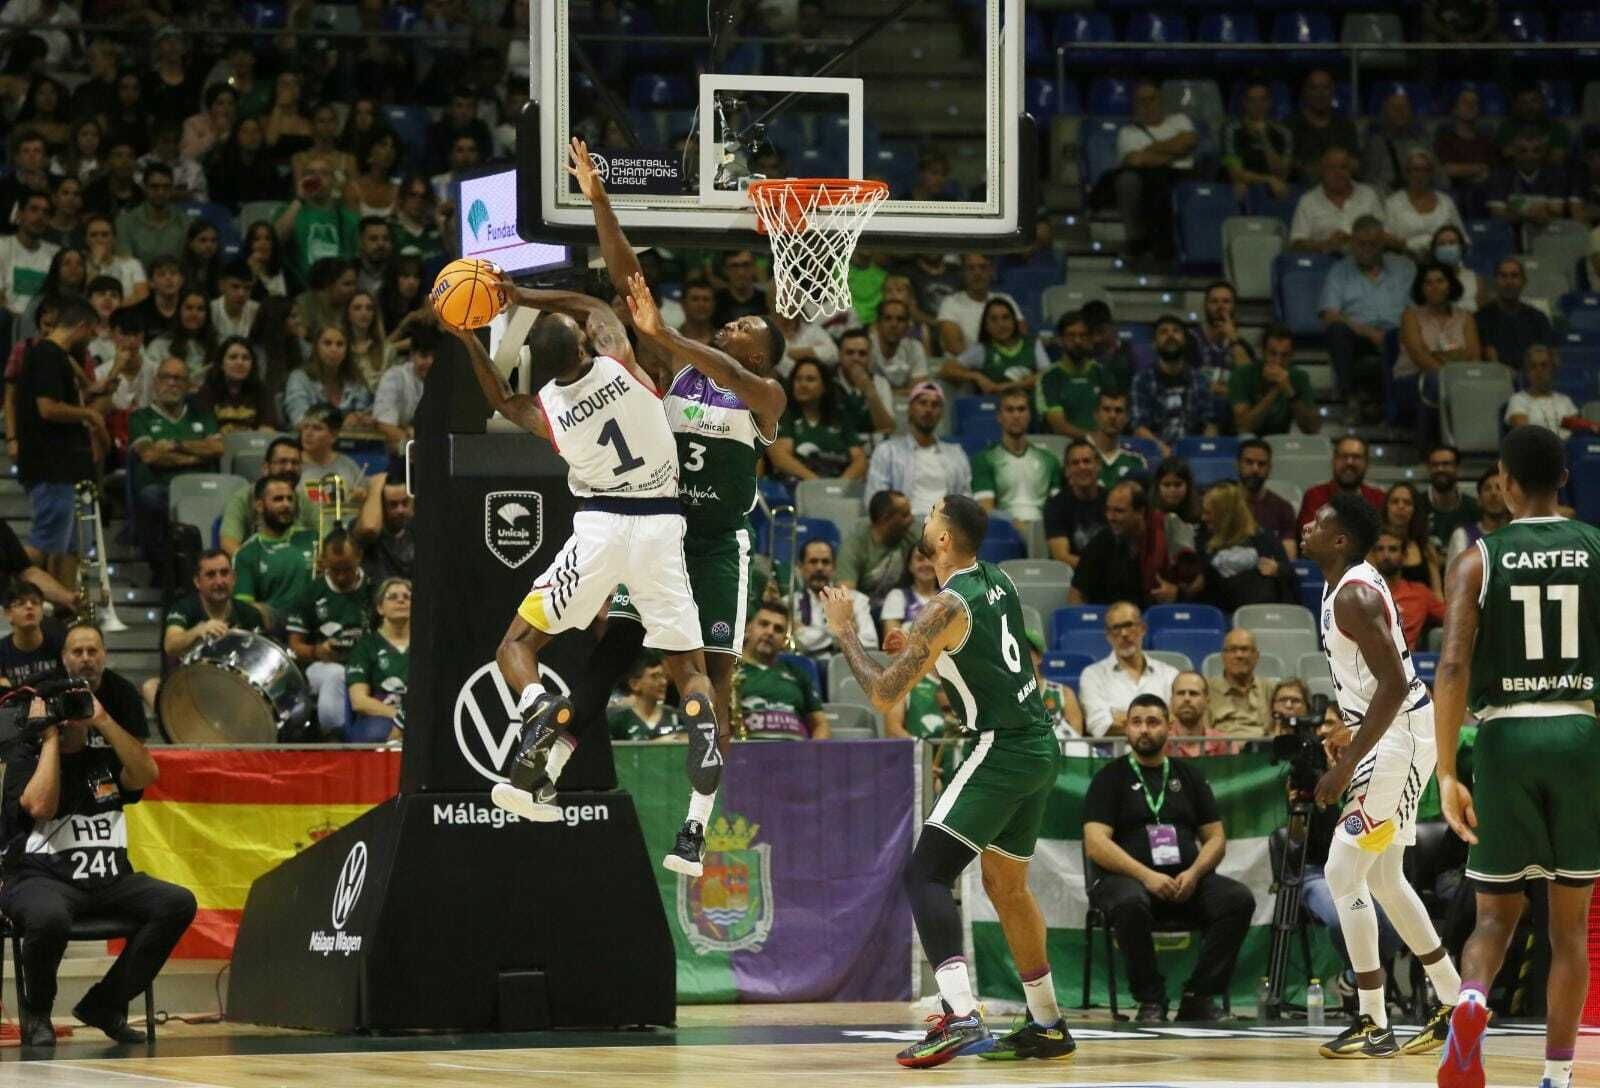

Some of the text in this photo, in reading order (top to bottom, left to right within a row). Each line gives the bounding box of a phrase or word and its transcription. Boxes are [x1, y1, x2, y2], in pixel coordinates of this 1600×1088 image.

[611, 158, 671, 168] BASKETBALL
[611, 167, 678, 178] CHAMPIONS
[611, 177, 648, 186] LEAGUE
[558, 375, 631, 432] MCDUFFIE
[597, 417, 645, 476] 1
[683, 441, 707, 472] 3
[497, 527, 530, 539] Unicaja
[1501, 550, 1590, 569] CARTER
[1510, 584, 1579, 660] 11
[1001, 613, 1021, 673] 6
[1502, 673, 1594, 692] BENAHAVÍS
[72, 818, 111, 842] HB
[71, 850, 119, 880] 241
[309, 930, 362, 957] Málaga Wagen
